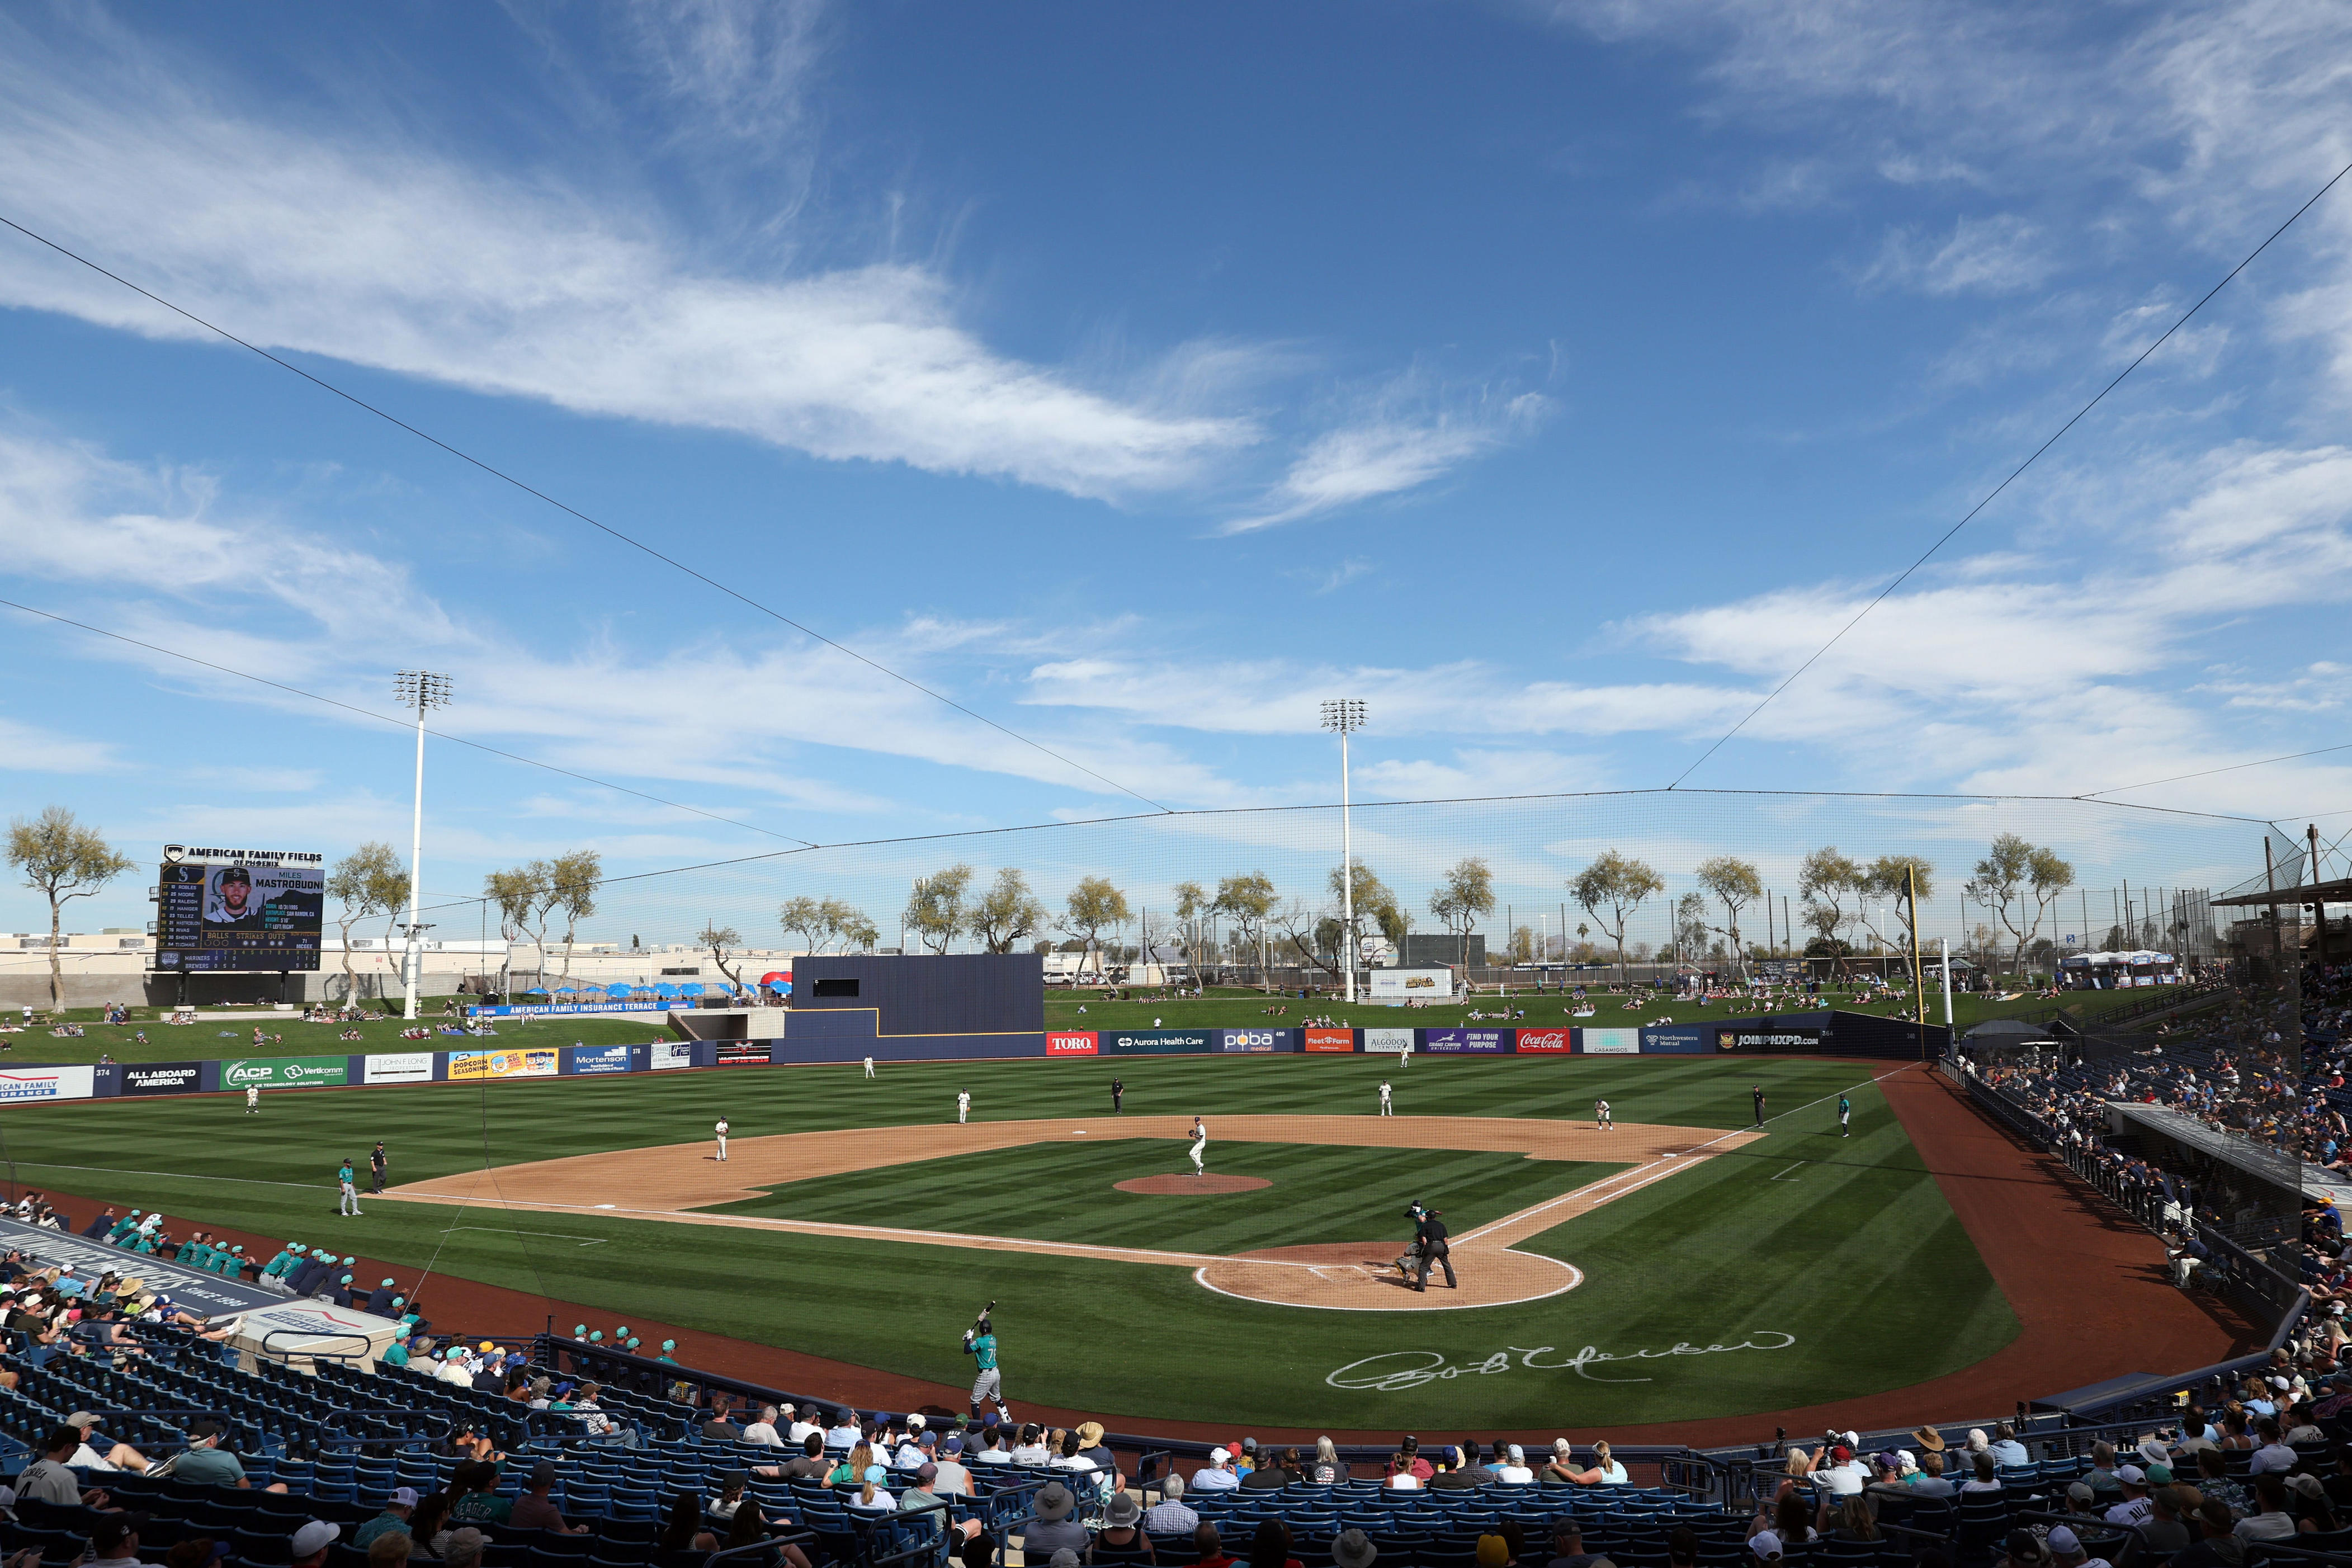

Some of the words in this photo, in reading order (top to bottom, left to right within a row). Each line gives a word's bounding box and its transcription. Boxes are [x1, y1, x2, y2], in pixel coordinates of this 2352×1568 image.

[188, 848, 244, 858] AMERICAN
[248, 851, 286, 859] FAMILY
[288, 853, 322, 861] FIELDS
[256, 879, 323, 889] MASTROBUONI
[580, 1003, 622, 1012] INSURANCE
[1052, 1037, 1091, 1050] TORO
[1225, 1029, 1272, 1051] poba
[1520, 1033, 1566, 1049] Coca-Cola
[454, 1059, 488, 1069] POPCORN
[150, 1069, 196, 1079] ABOARD
[233, 1067, 272, 1078] ACP
[454, 1065, 488, 1075] SEASONING
[25, 1081, 57, 1089] FAMILY
[135, 1078, 185, 1087] AMERICA
[180, 1287, 222, 1299] SINCE
[213, 1297, 248, 1307] 1998
[266, 1314, 330, 1333] INSURANCE
[22, 1468, 48, 1480] CORREA
[456, 1502, 492, 1519] SEAGER
